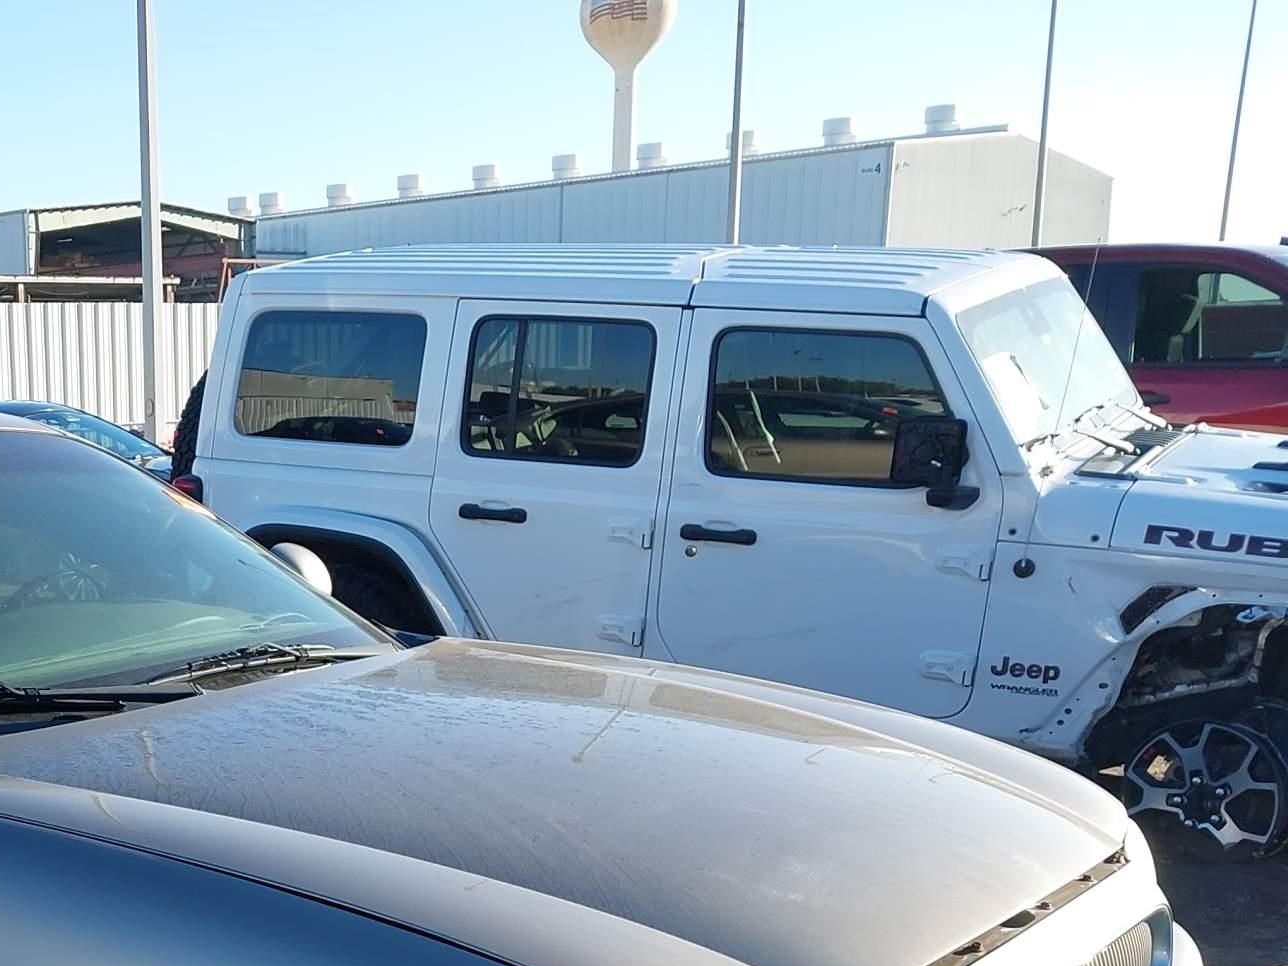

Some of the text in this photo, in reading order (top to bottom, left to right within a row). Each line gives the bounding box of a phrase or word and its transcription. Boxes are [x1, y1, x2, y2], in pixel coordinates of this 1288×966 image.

[874, 162, 881, 174] 4
[1143, 524, 1288, 559] RUB
[990, 655, 1061, 684] Jeep
